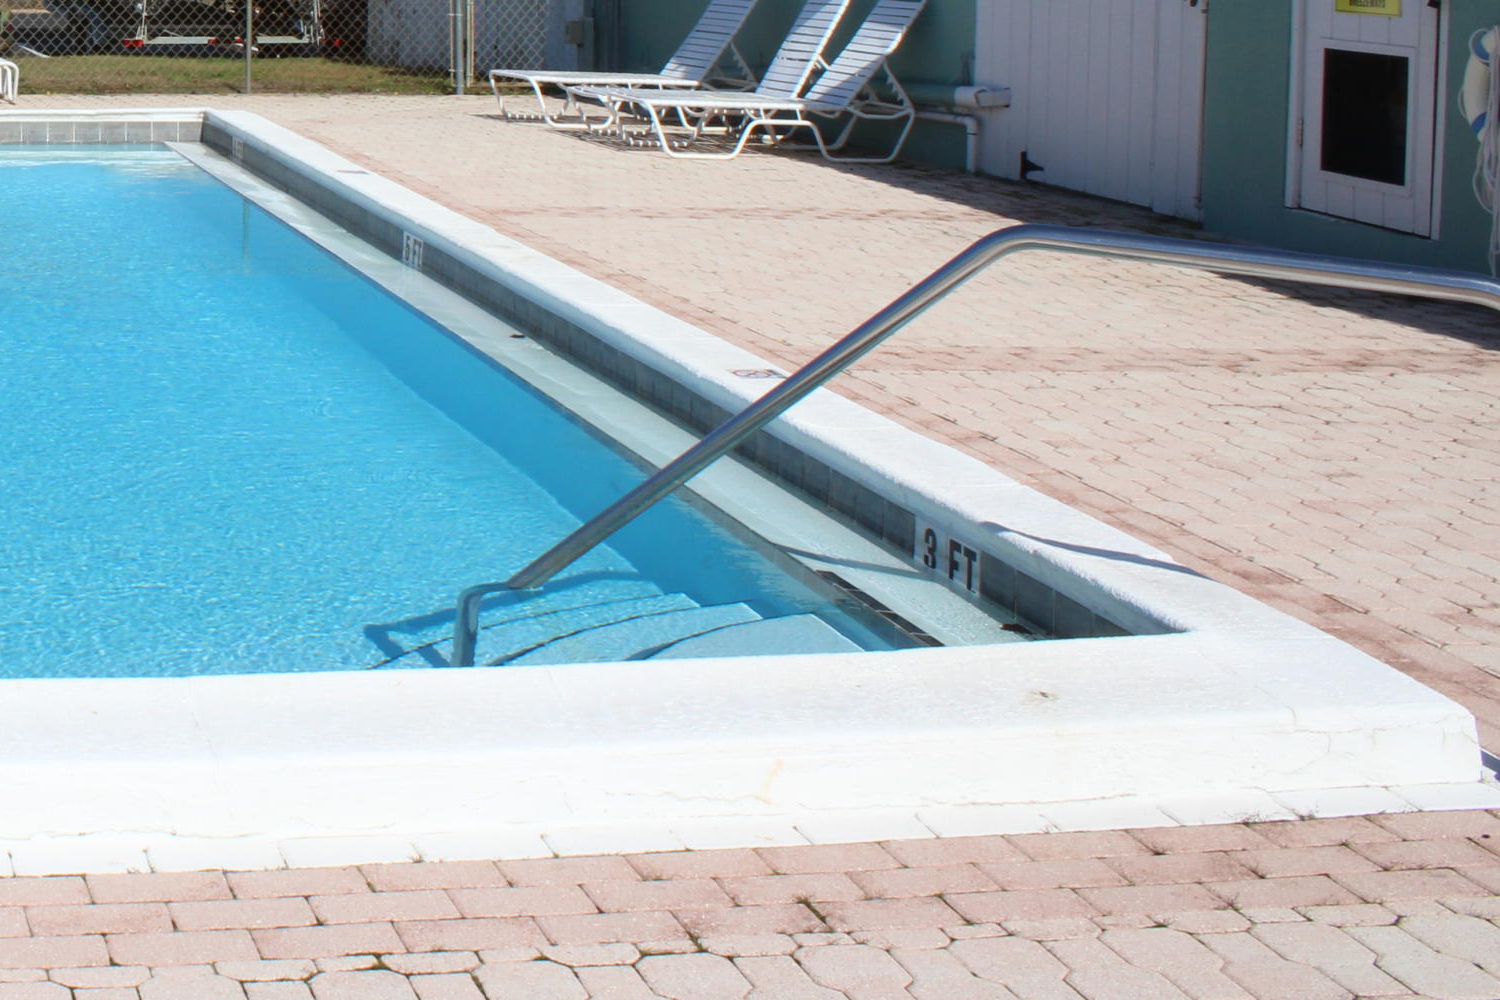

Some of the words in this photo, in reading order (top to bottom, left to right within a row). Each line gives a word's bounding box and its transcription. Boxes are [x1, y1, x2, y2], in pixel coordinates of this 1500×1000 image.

[412, 239, 422, 268] FT
[923, 527, 937, 569] 3
[948, 538, 977, 594] FT
